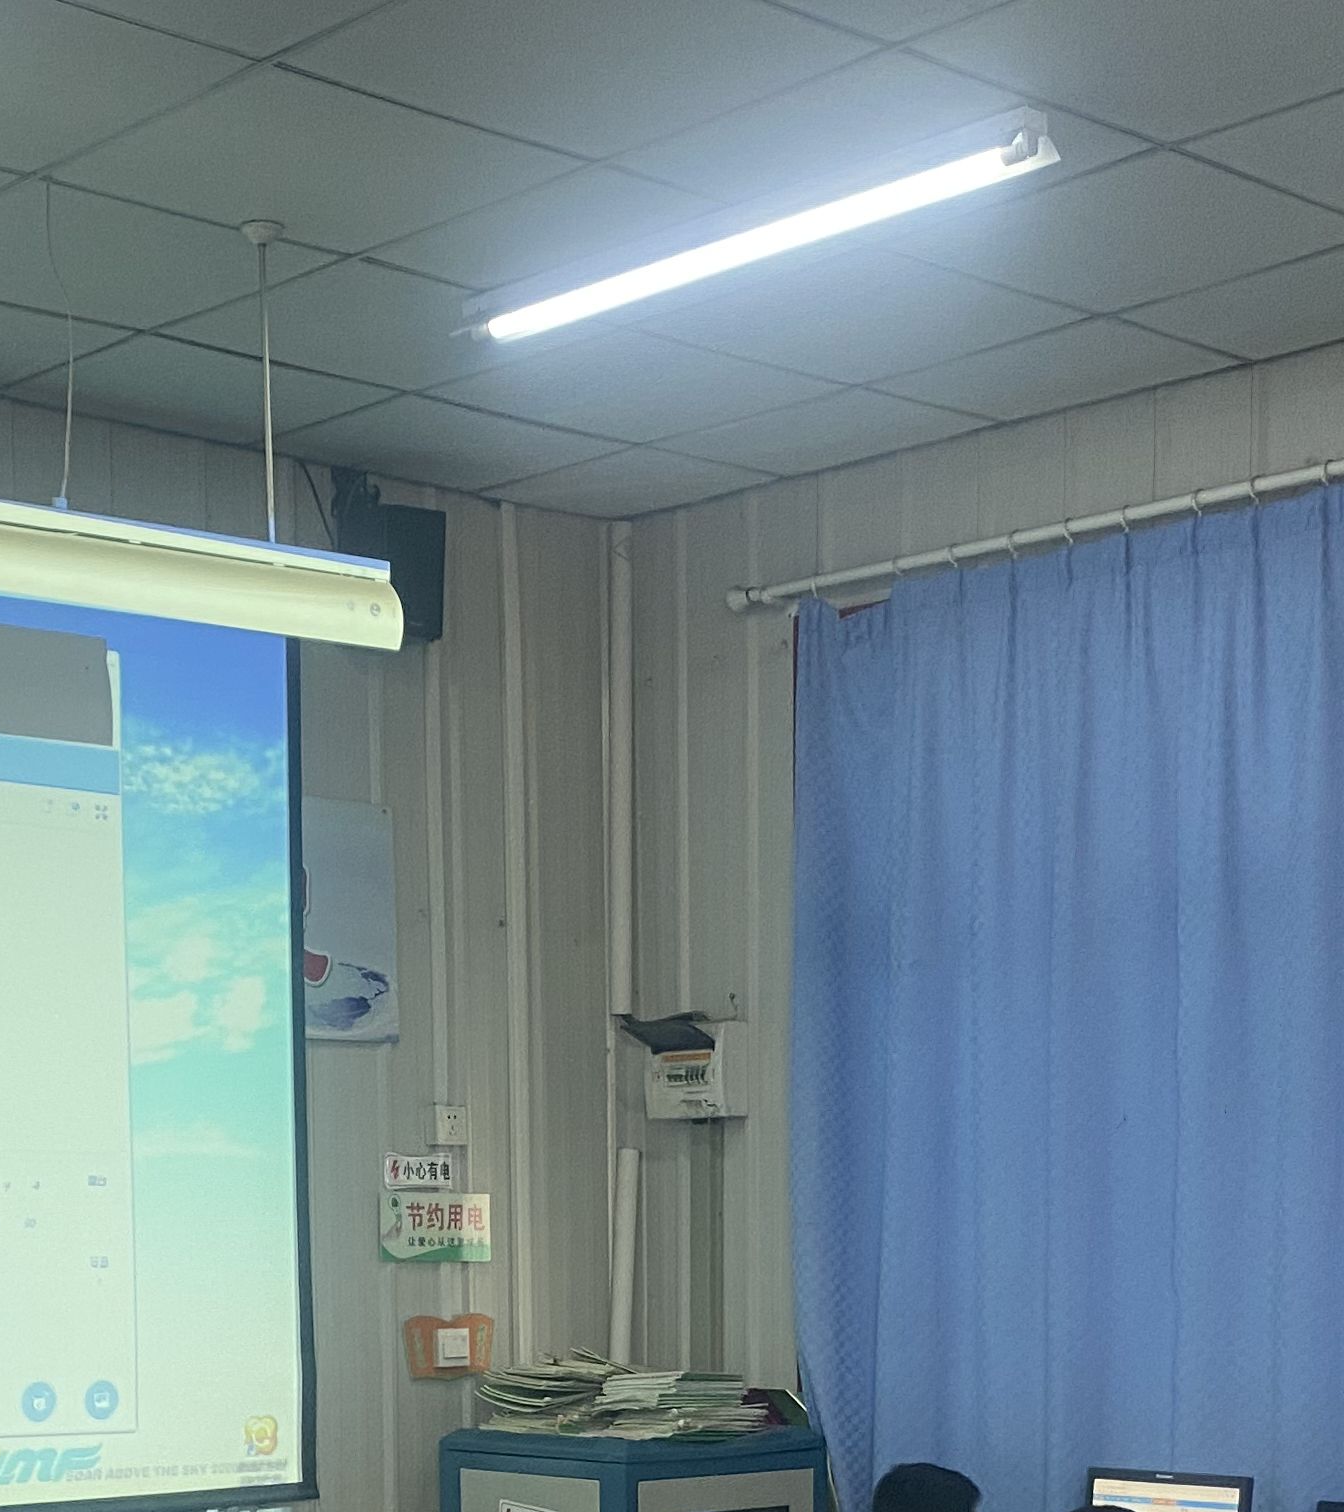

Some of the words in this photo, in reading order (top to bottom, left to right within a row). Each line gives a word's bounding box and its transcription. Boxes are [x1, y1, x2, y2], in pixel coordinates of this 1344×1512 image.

[403, 1161, 450, 1180] 小心有电
[406, 1202, 485, 1231] 节约用电
[155, 1464, 180, 1478] THE
